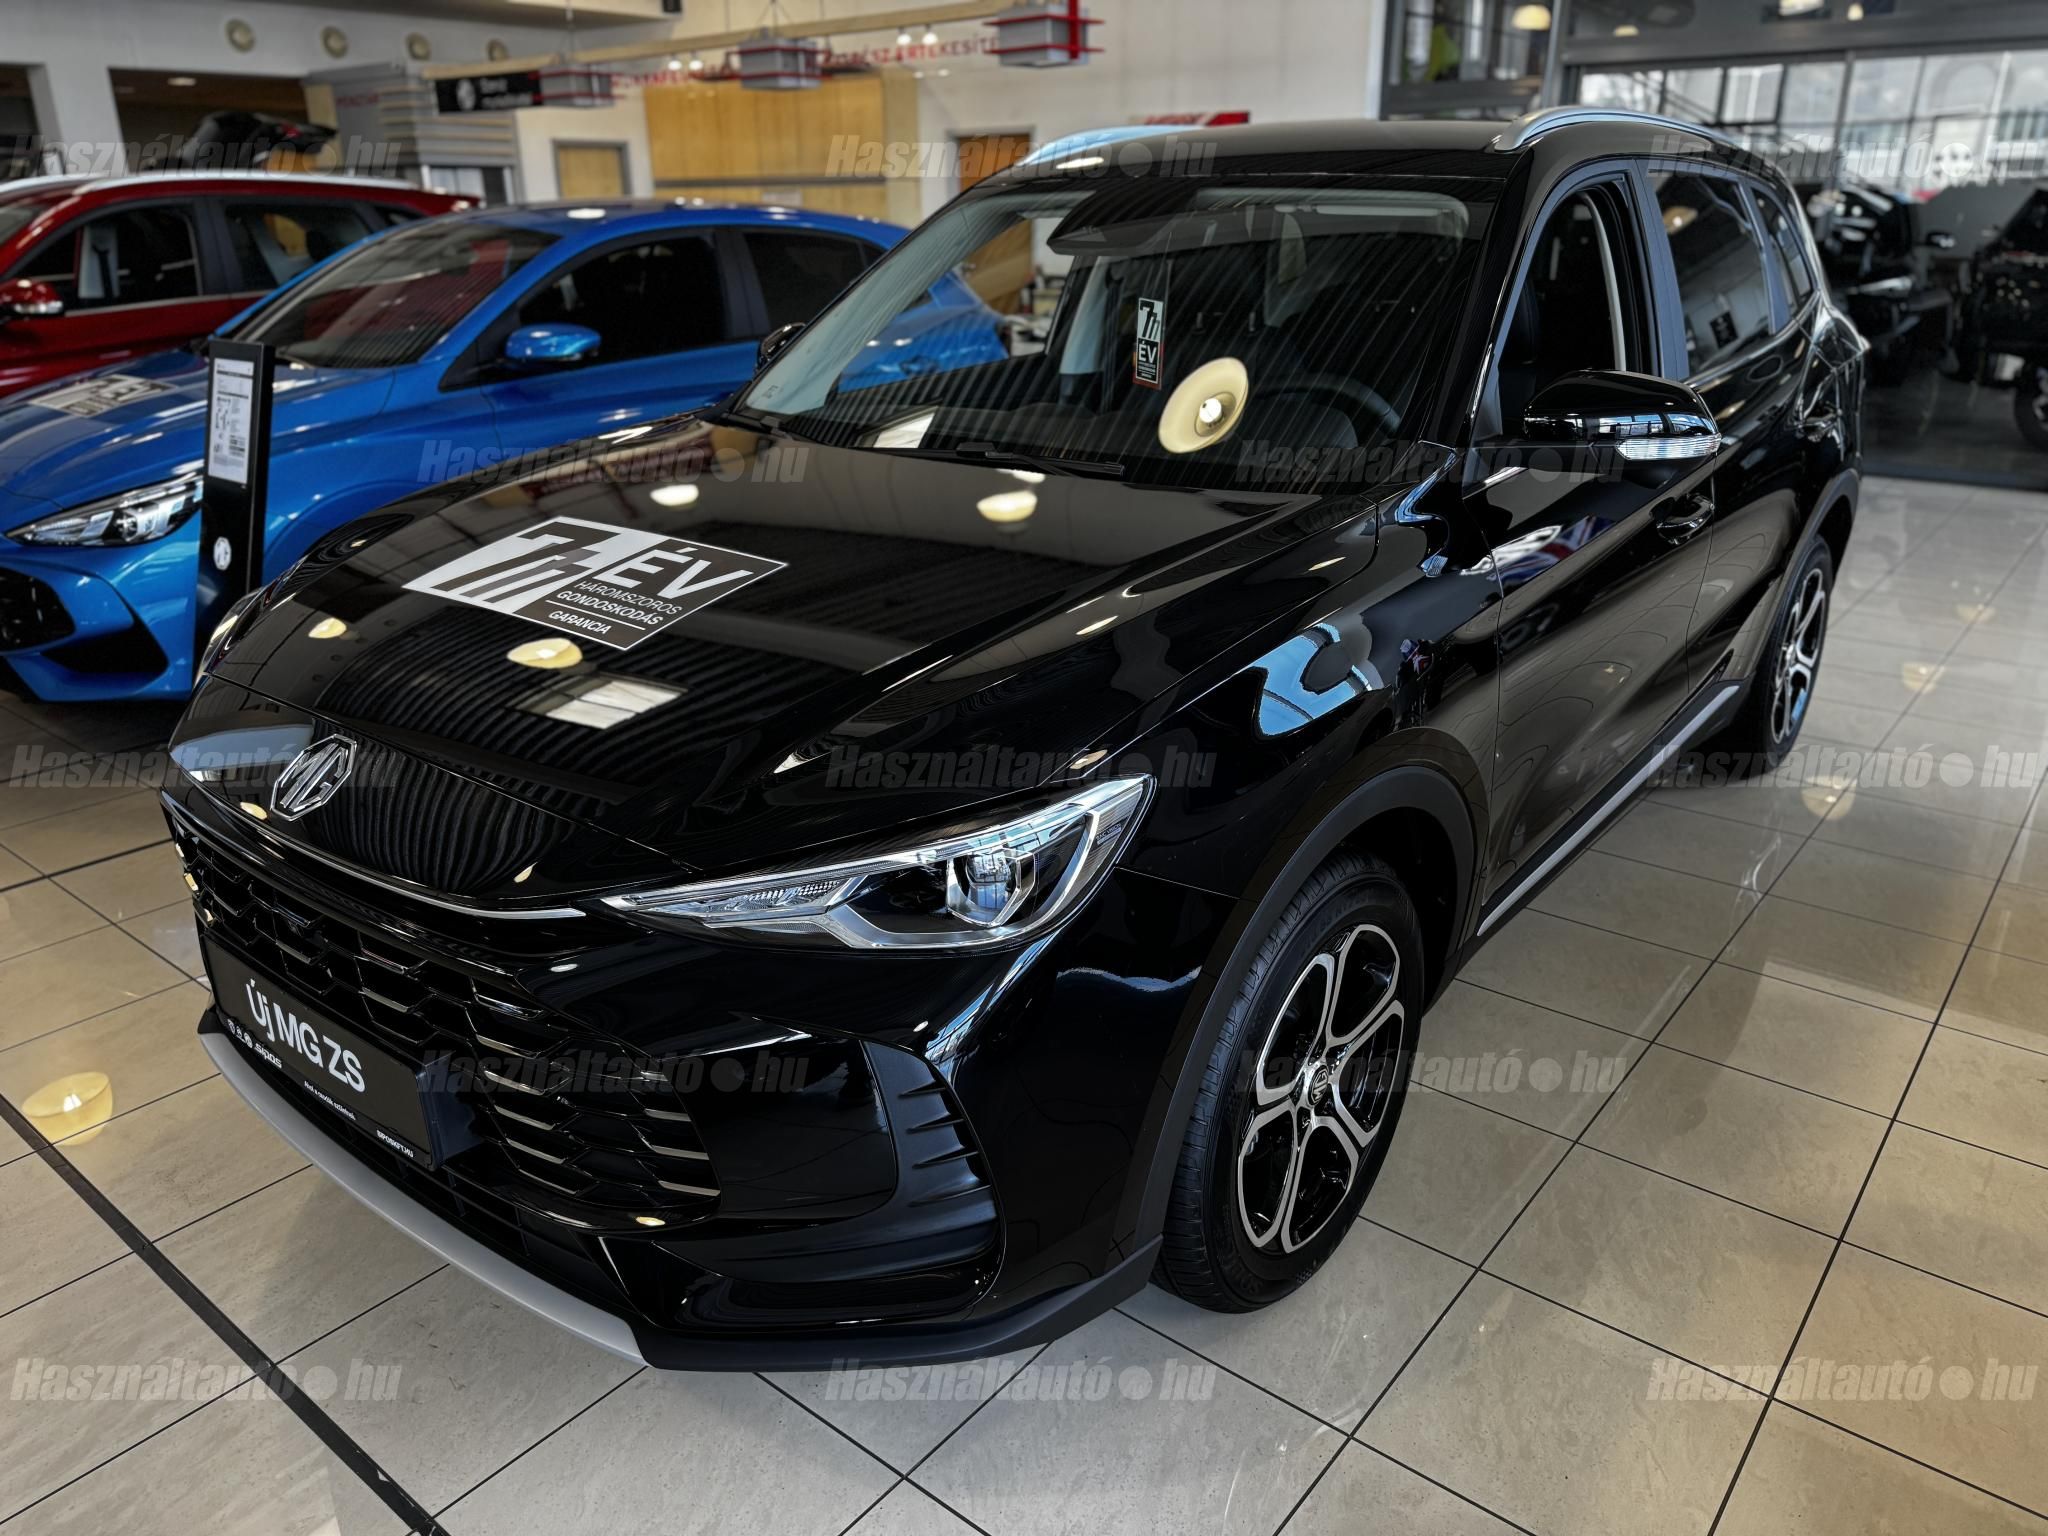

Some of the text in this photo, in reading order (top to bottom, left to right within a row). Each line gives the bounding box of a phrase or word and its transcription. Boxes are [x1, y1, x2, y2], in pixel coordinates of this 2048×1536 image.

[1138, 341, 1157, 363] ÉV
[592, 546, 754, 599] ÉV
[555, 590, 664, 626] GONDOSKODÁS
[574, 580, 683, 616] HÁROMSZOROS
[548, 610, 613, 635] GARANCIA
[277, 740, 349, 813] MG
[246, 978, 366, 1093] Új MG ZS
